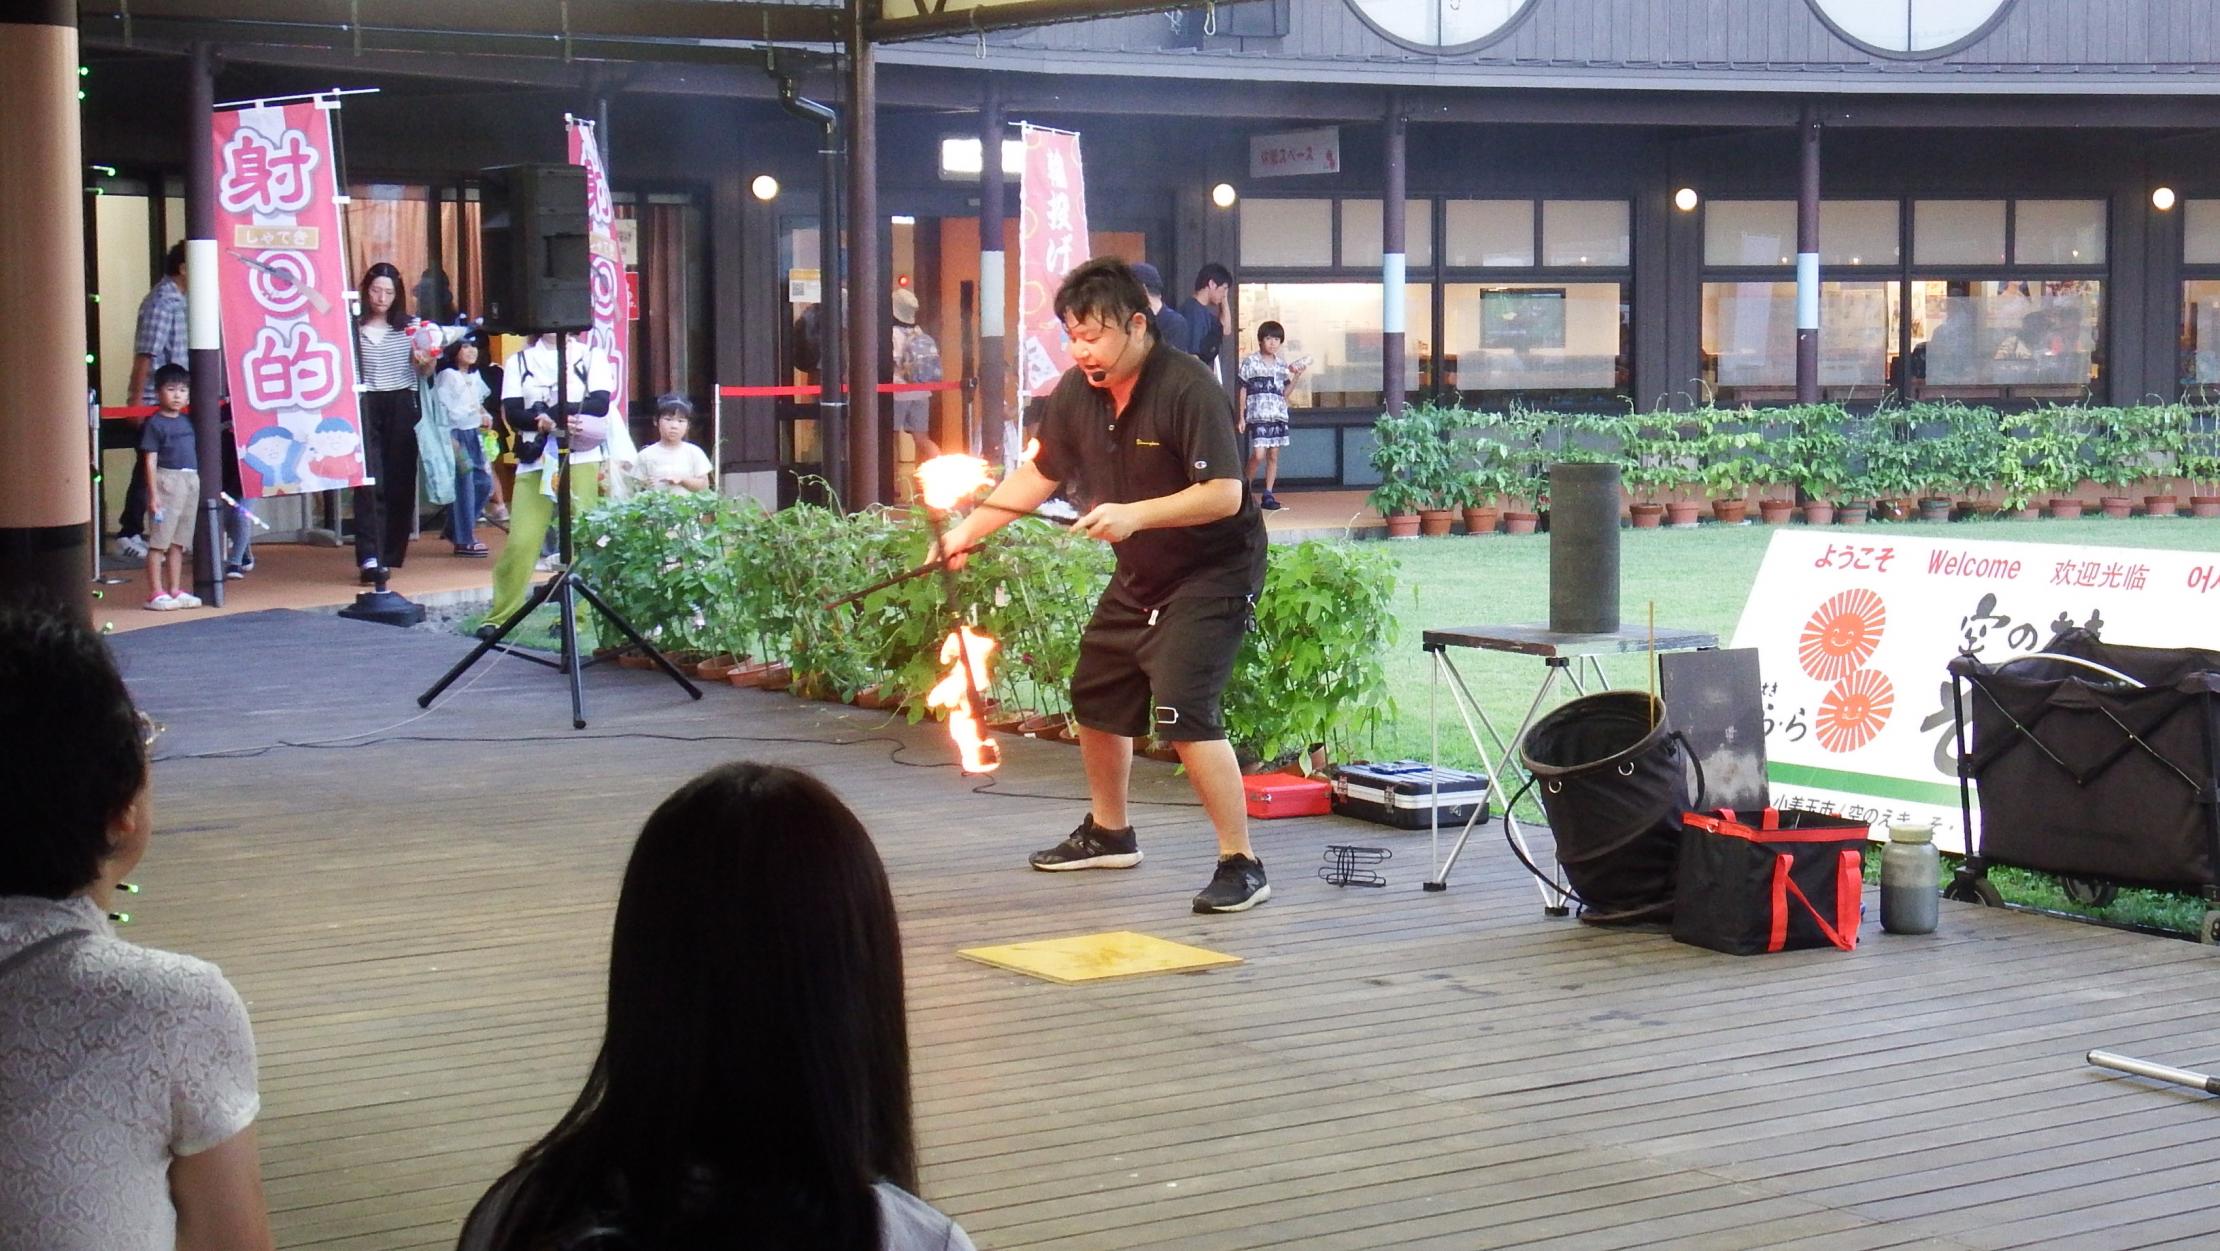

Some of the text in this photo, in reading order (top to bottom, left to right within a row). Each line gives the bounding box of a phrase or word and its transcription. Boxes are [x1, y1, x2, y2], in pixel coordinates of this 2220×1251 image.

[1815, 543, 1895, 573] ようこそ
[1928, 549, 2021, 579] Welcome
[2050, 559, 2150, 591] 欢迎光临
[2187, 565, 2220, 593] 어
